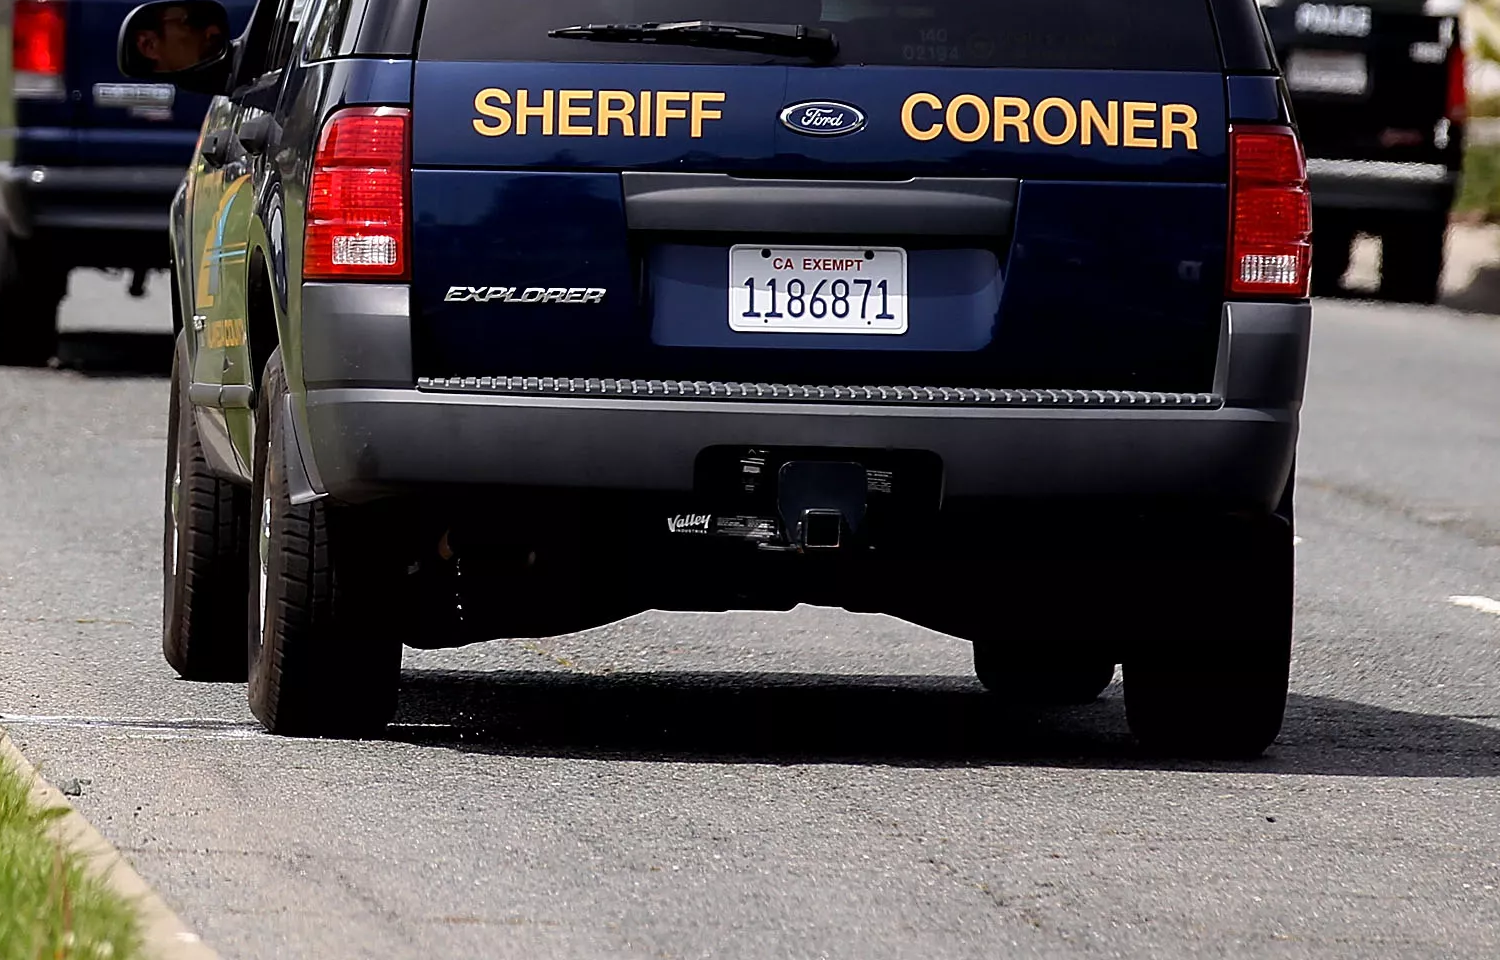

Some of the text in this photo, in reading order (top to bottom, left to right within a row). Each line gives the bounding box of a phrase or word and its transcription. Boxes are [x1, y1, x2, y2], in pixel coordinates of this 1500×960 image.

[472, 87, 727, 139] SHERIFF
[800, 107, 843, 127] Ford
[900, 92, 1198, 150] CORONER
[772, 258, 863, 272] CA EXEMPT
[444, 286, 607, 304] EXPLORER
[742, 276, 895, 320] 1186871
[667, 514, 711, 532] Valley
